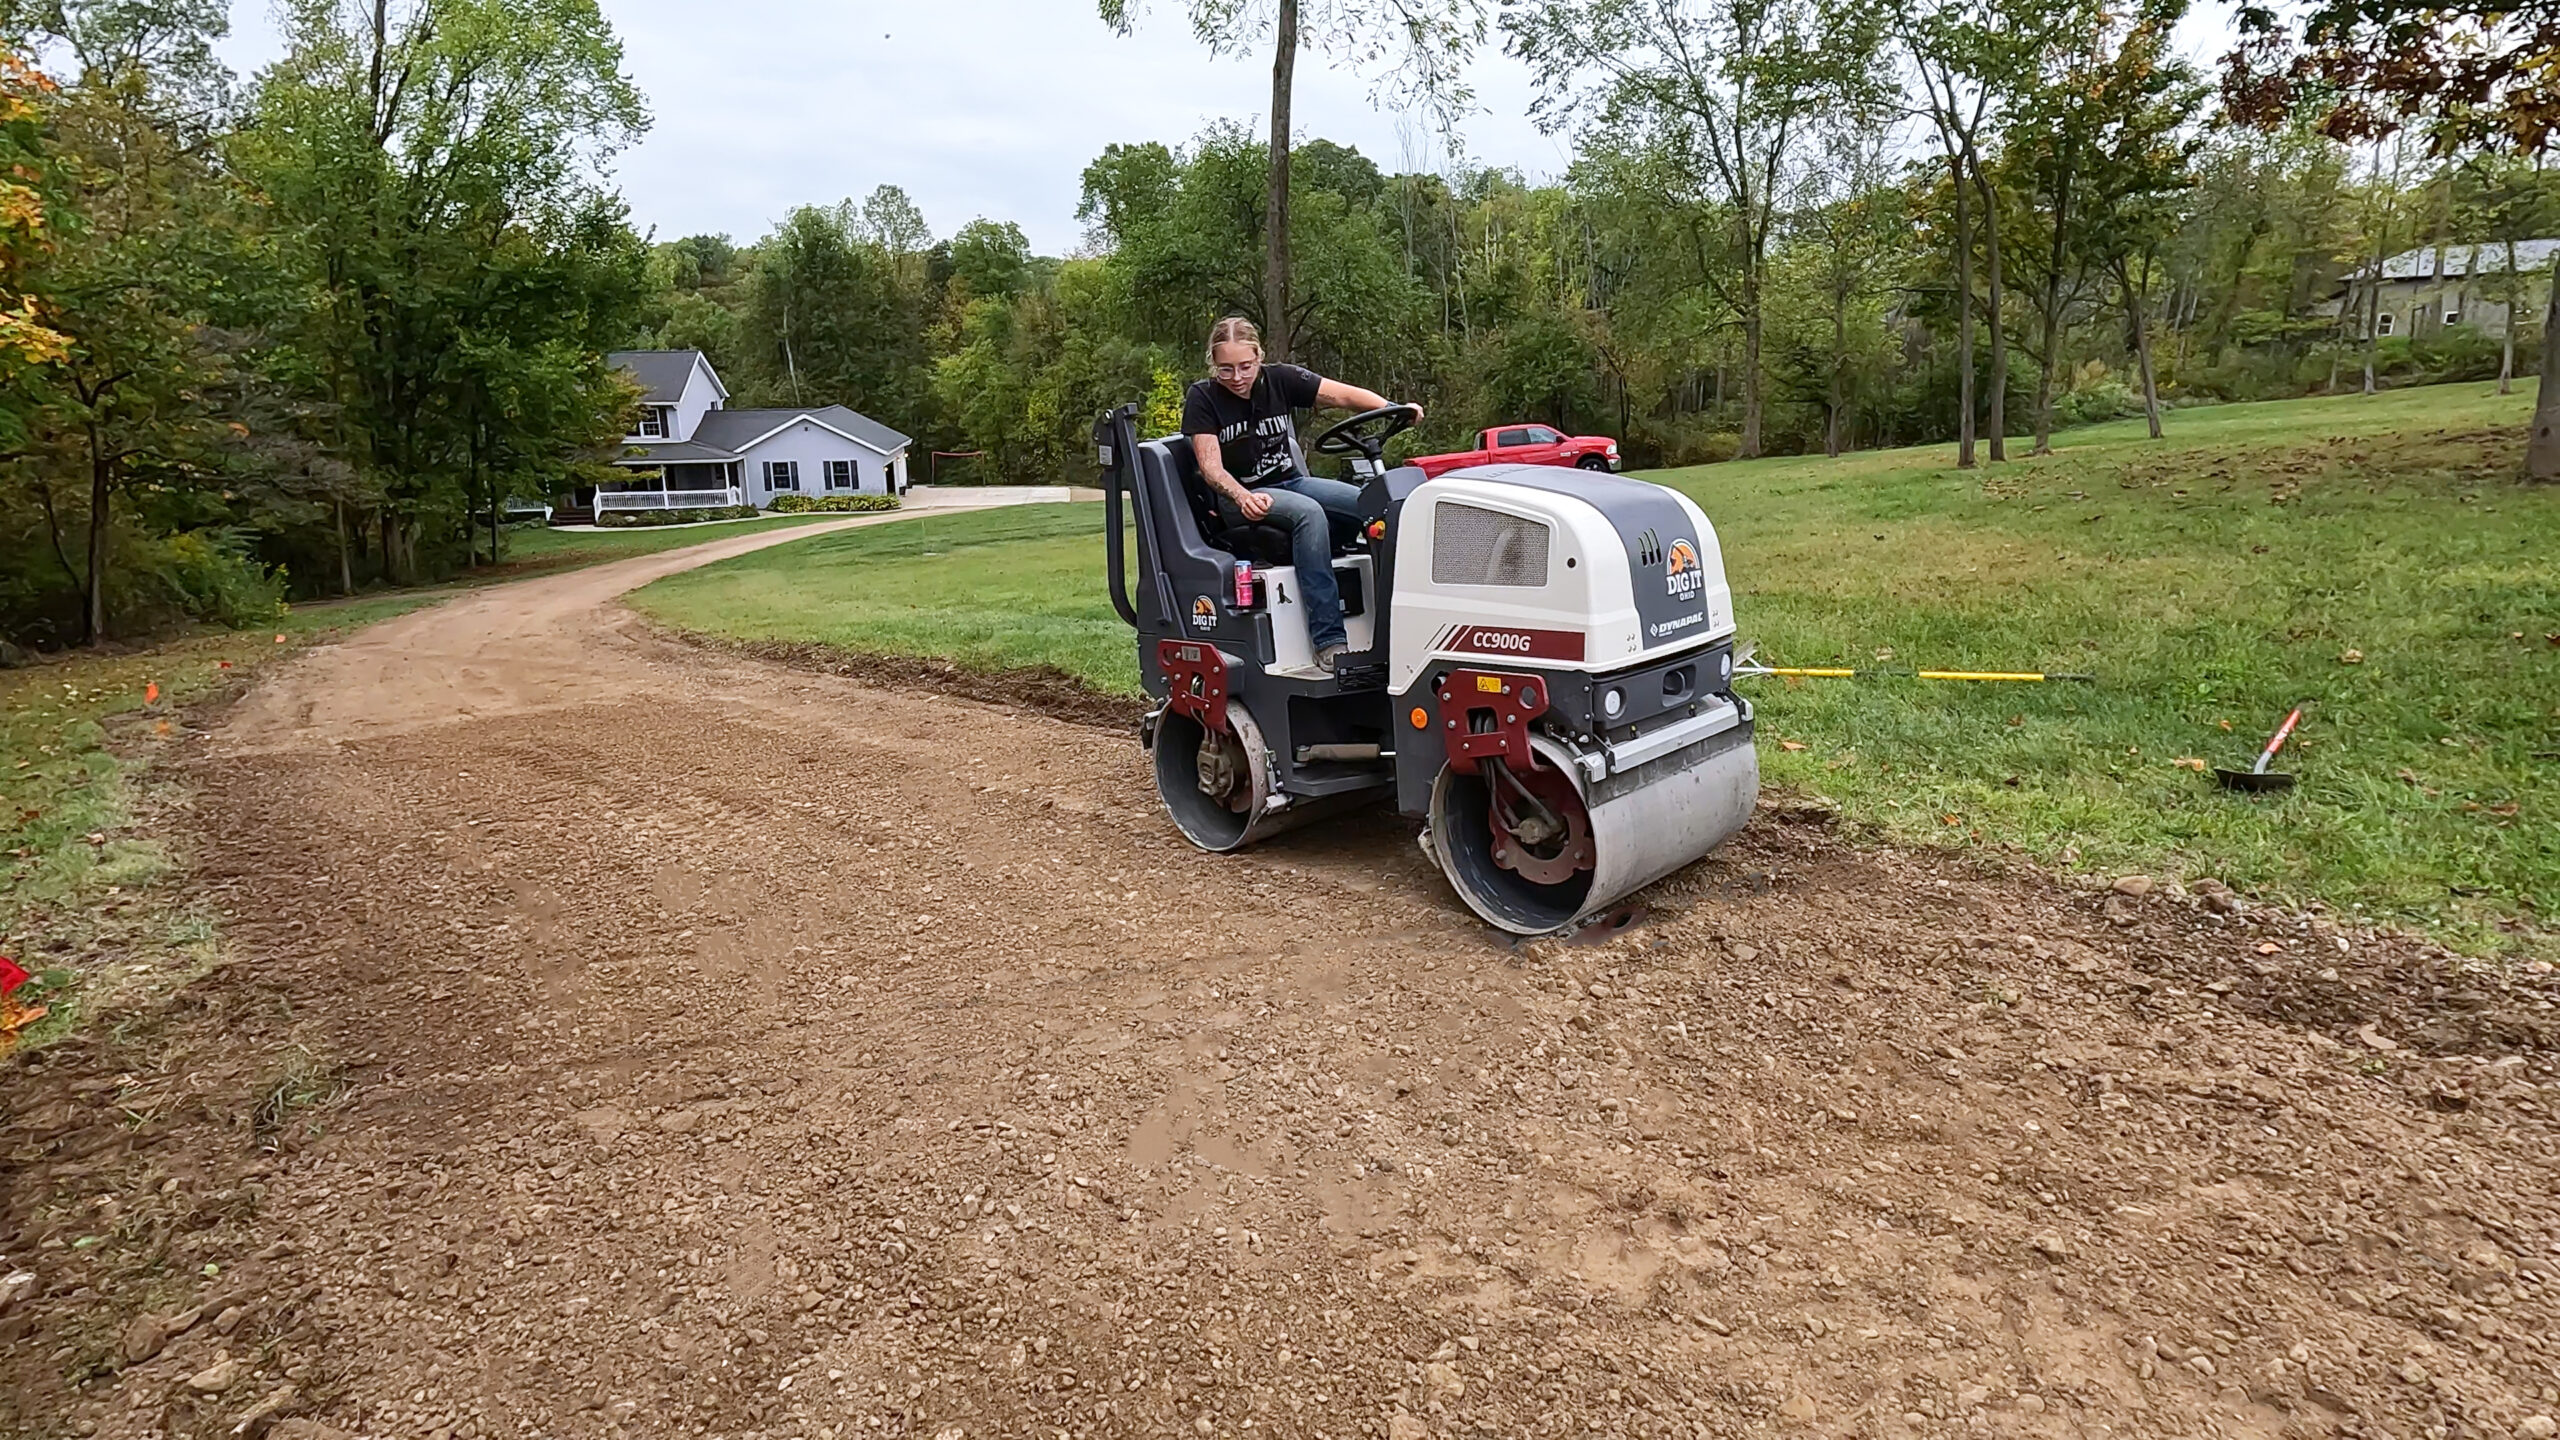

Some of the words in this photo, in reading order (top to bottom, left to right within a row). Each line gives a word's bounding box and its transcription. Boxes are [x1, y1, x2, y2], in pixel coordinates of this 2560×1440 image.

[1219, 414, 1288, 443] QUANTIN
[1666, 573, 1690, 595] DIG
[1690, 569, 1702, 589] IT
[1192, 614, 1207, 626] DIG
[1208, 615, 1217, 627] IT
[1658, 611, 1704, 633] DYNAPAC
[1473, 631, 1532, 652] CC900G
